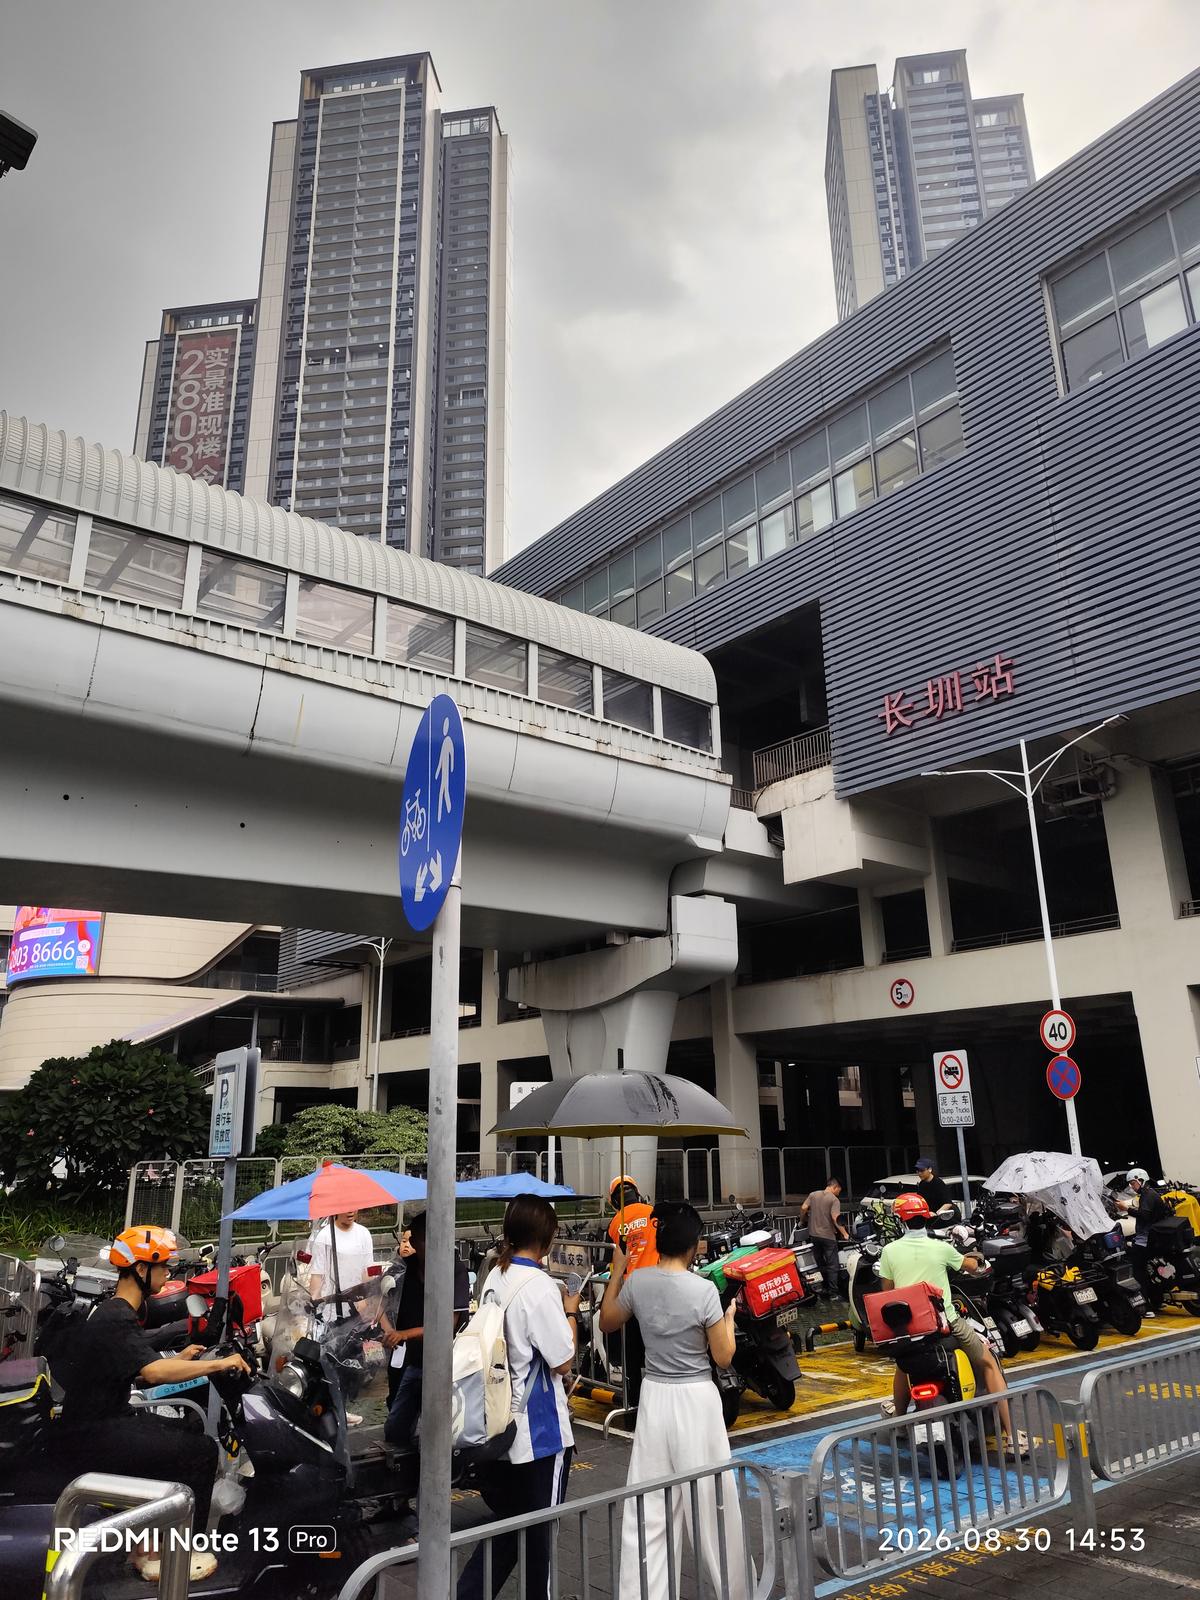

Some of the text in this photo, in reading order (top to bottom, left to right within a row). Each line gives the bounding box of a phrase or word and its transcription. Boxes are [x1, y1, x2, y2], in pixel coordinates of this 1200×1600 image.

[172, 349, 204, 473] 2803
[878, 654, 1014, 735] 长圳站
[31, 940, 75, 963] 8666
[1049, 1022, 1067, 1041] 40
[220, 1079, 229, 1110] P
[941, 1095, 969, 1106] 泥头车
[216, 1112, 232, 1126] 自行车
[941, 1107, 955, 1115] Dump
[758, 1273, 791, 1293] 京东秒送
[761, 1282, 793, 1303] 好物立享
